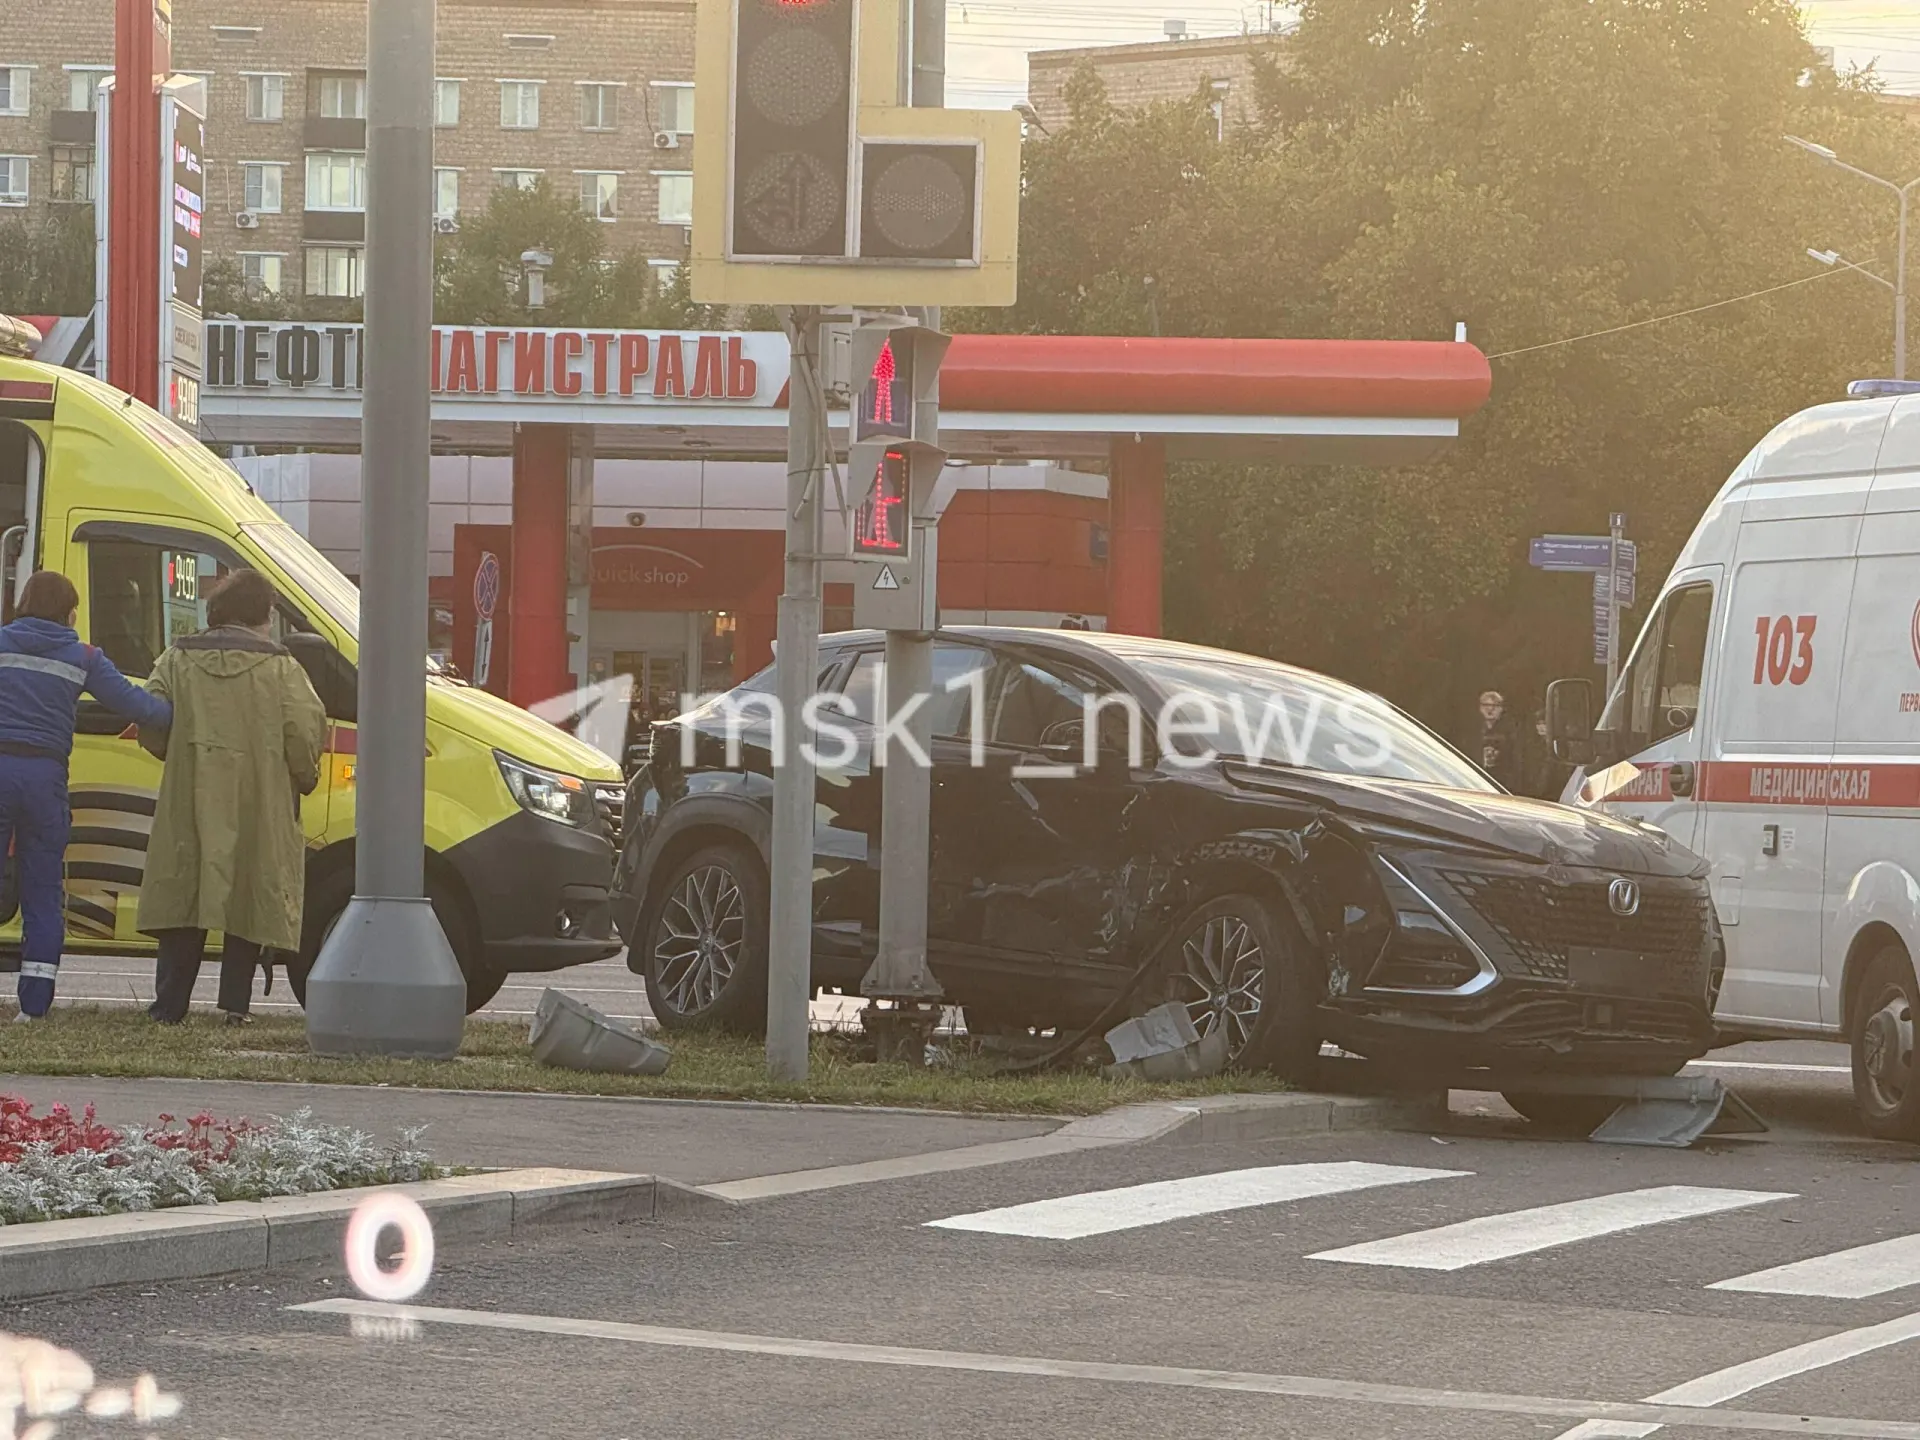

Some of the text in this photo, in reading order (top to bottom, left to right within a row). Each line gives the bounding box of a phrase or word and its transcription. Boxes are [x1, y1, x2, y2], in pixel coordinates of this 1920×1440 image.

[206, 324, 757, 398] НЕФТАГИСТРАЛЬ
[644, 566, 689, 588] shop
[1753, 614, 1817, 686] 103
[1899, 692, 1920, 713] ПЕРВ
[1750, 767, 1871, 804] МЕДИЦИНСКАЯ
